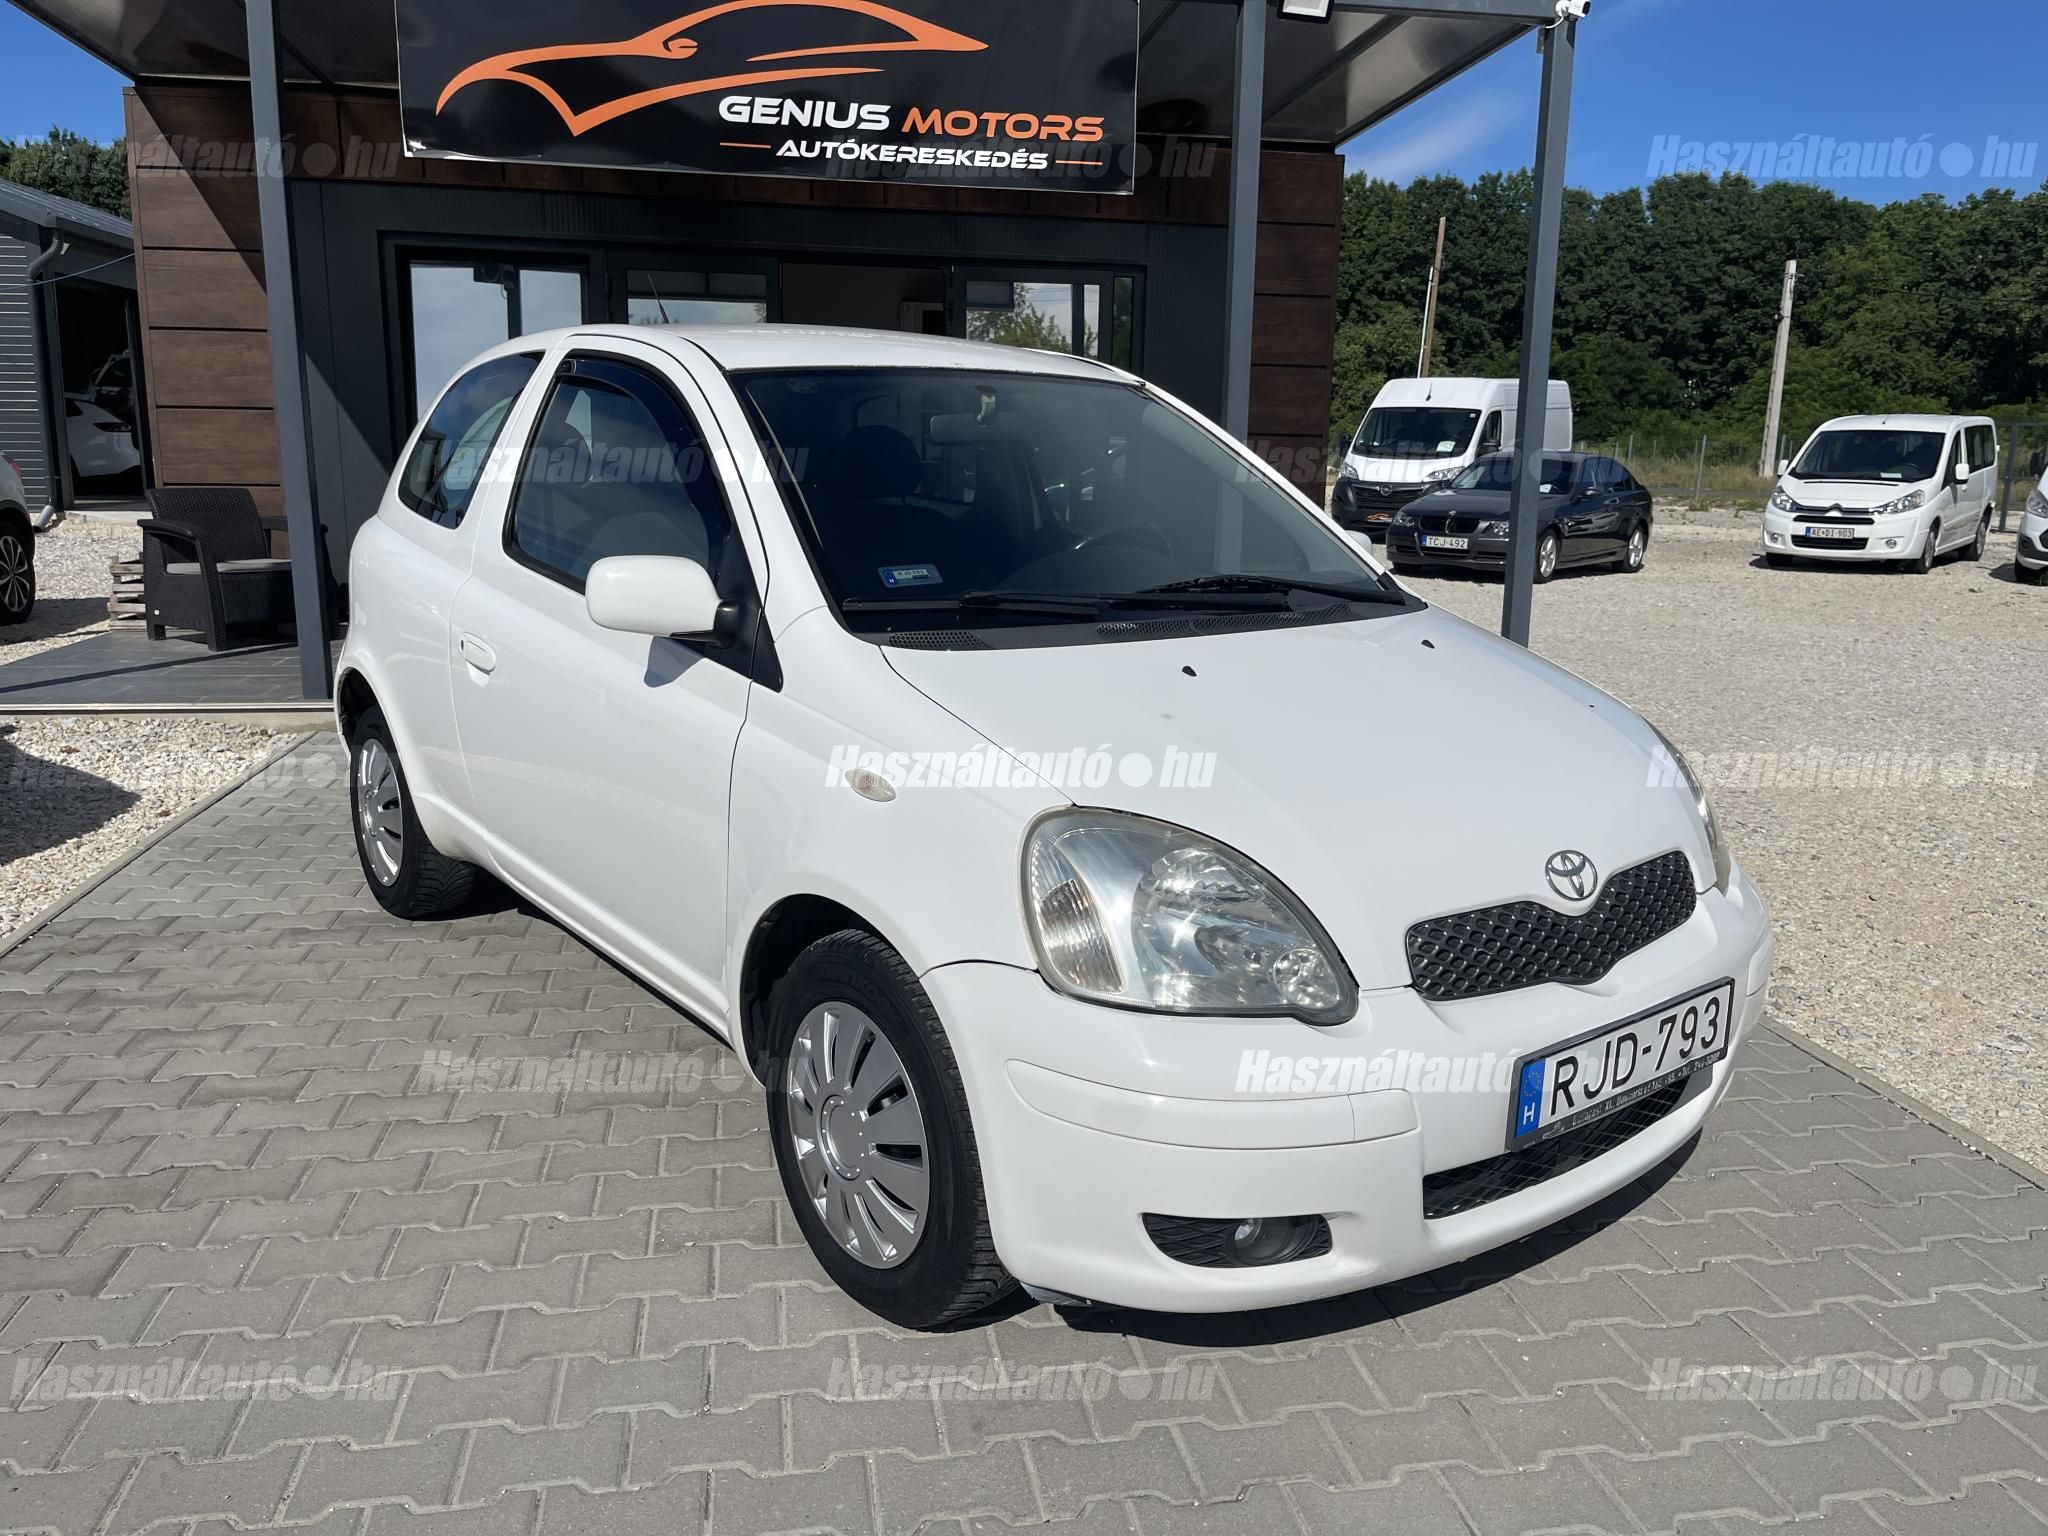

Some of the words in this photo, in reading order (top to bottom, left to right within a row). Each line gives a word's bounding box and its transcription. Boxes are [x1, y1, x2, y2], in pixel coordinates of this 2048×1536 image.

[718, 95, 892, 131] GENIUS
[901, 106, 1105, 142] MOTORS
[775, 138, 1049, 170] AUTÓKERESKEDÉS
[1428, 537, 1466, 548] TCJ-492
[1522, 1102, 1535, 1126] H
[1550, 996, 1721, 1117] RJD-793
